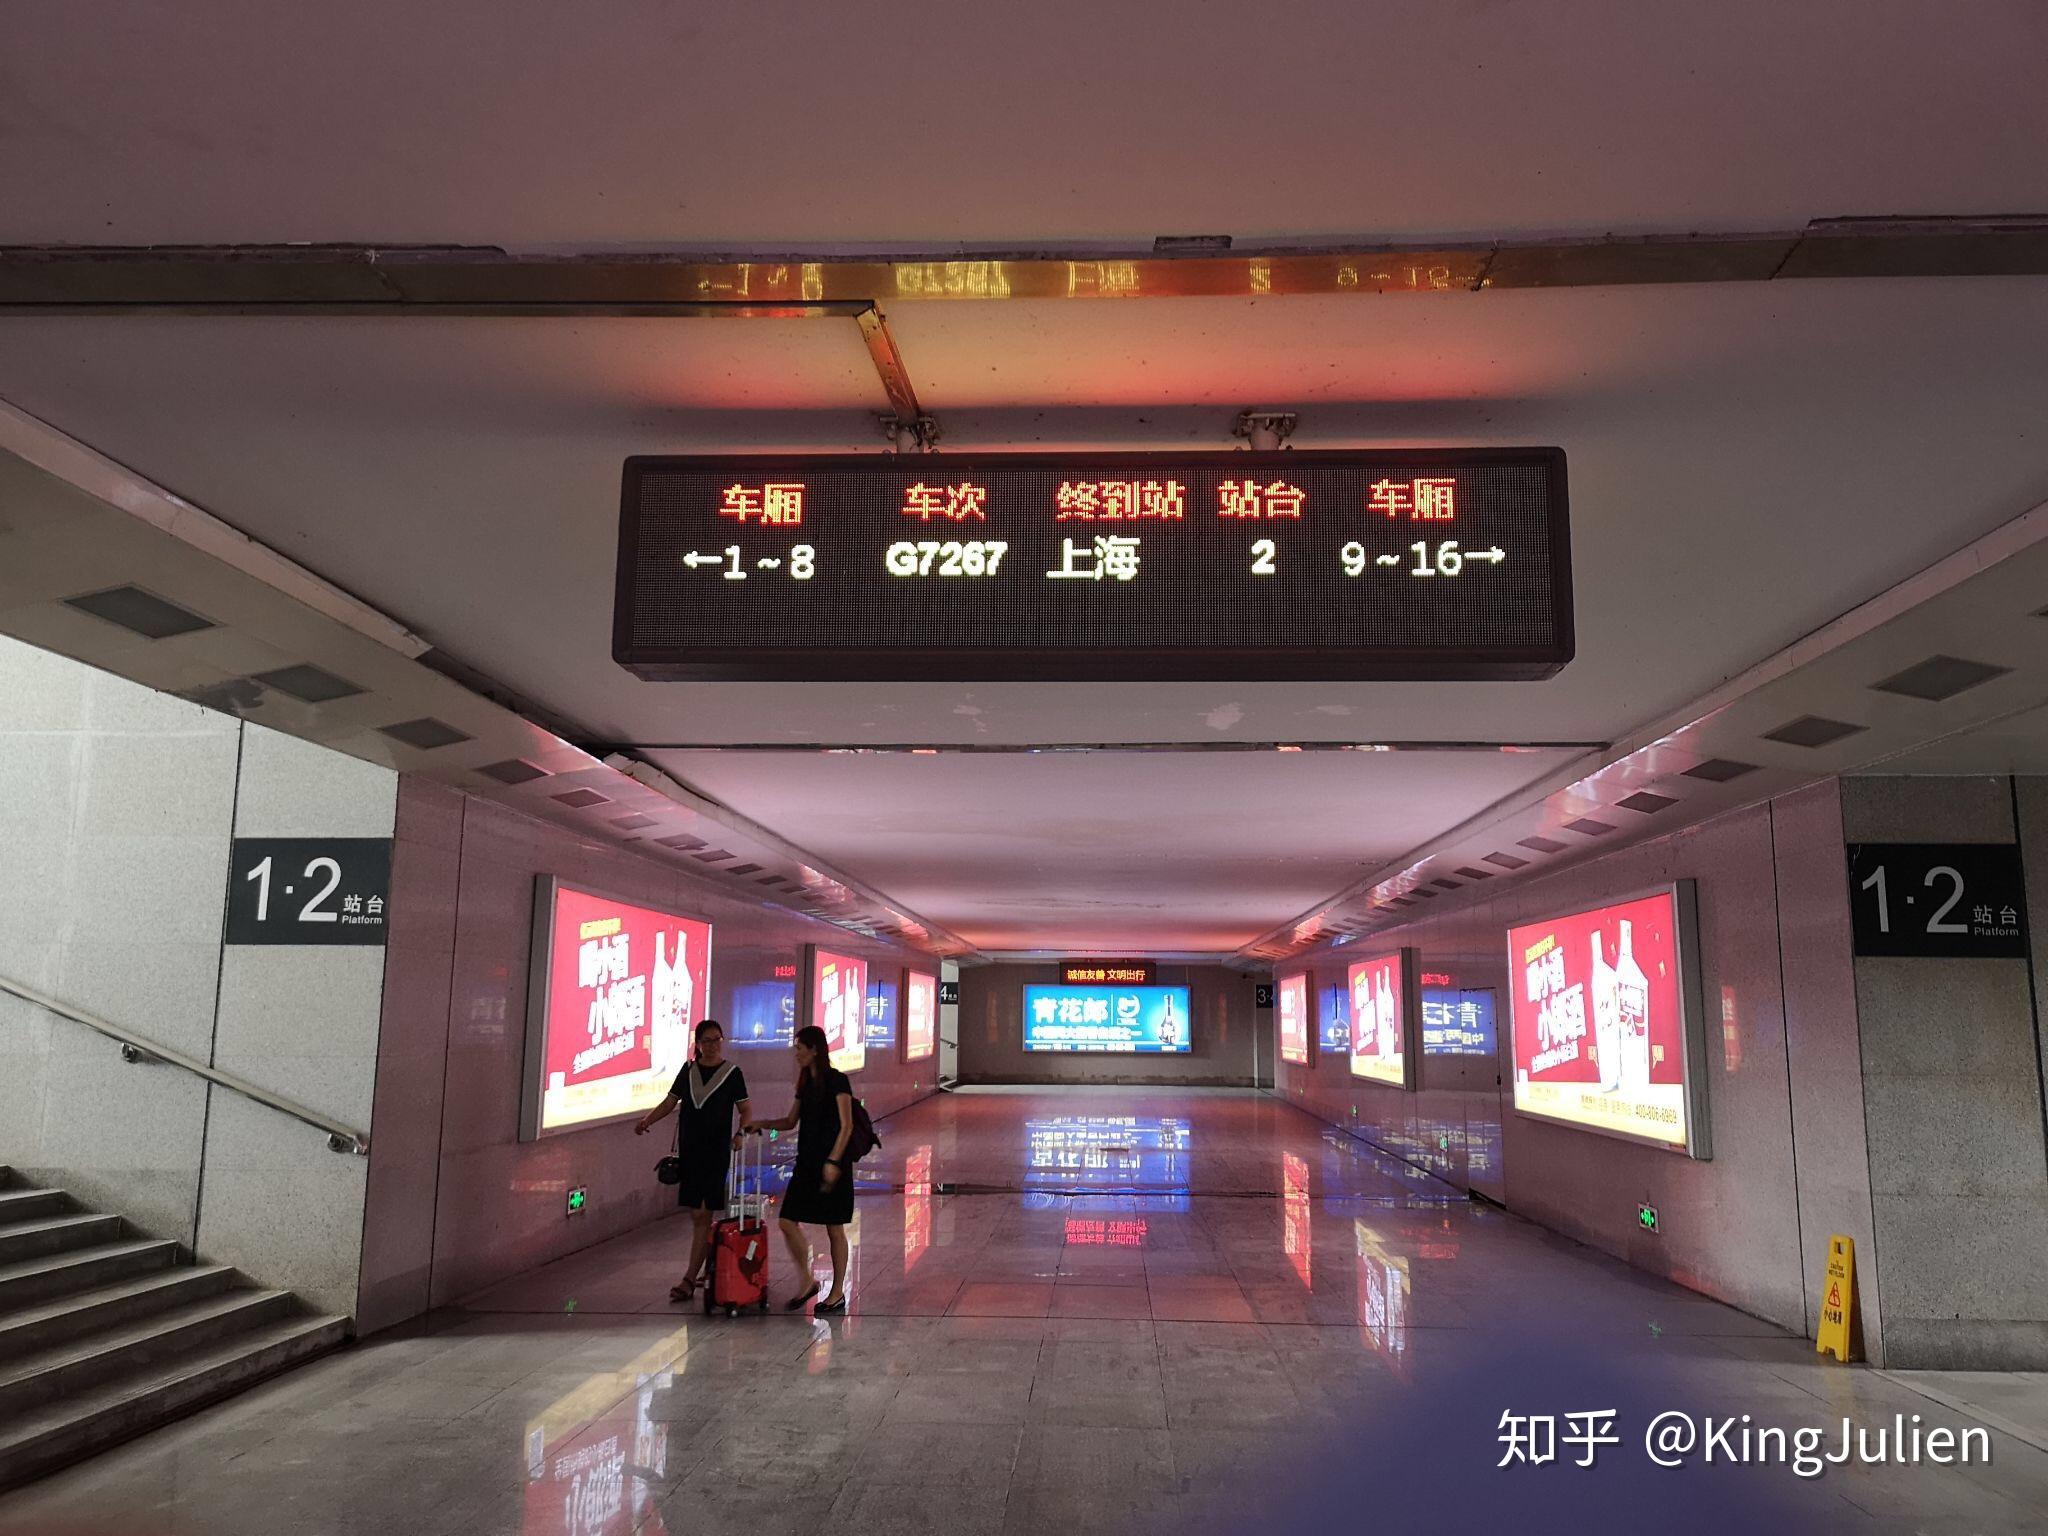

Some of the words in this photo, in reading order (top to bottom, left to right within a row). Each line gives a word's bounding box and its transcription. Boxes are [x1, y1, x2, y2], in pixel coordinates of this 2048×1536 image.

[718, 482, 806, 525] 车厢
[902, 481, 988, 522] 车次
[1056, 480, 1186, 520] 终到站
[1217, 478, 1307, 518] 站台
[1367, 477, 1457, 520] 车厢
[885, 541, 1009, 578] G7267
[1045, 534, 1142, 581] 上海
[1250, 539, 1277, 576] 2
[343, 893, 385, 914] 站台
[341, 915, 383, 925] Platform
[1972, 904, 2018, 926] 站台
[1973, 926, 2020, 937] Platform
[1107, 969, 1146, 981] 文明出行
